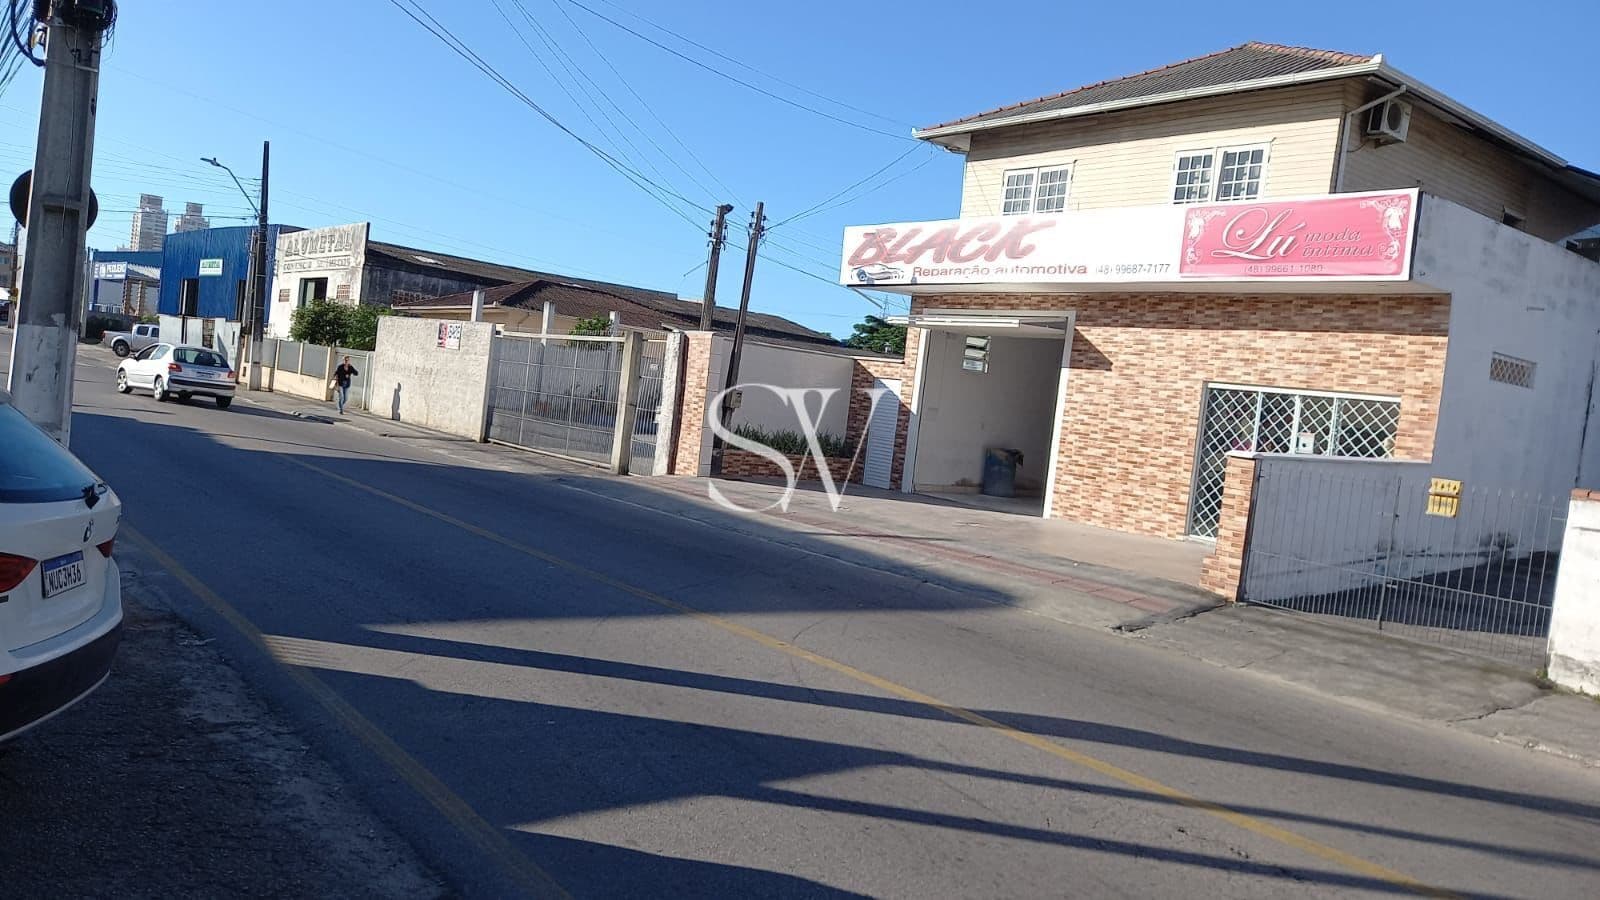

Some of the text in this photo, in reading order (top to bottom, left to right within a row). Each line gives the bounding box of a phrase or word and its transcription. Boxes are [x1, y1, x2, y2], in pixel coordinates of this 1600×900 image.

[848, 219, 1056, 266] BLACK
[1210, 207, 1306, 261] Lú
[1303, 226, 1361, 242] moda
[914, 263, 1088, 278] Reparação automotiva
